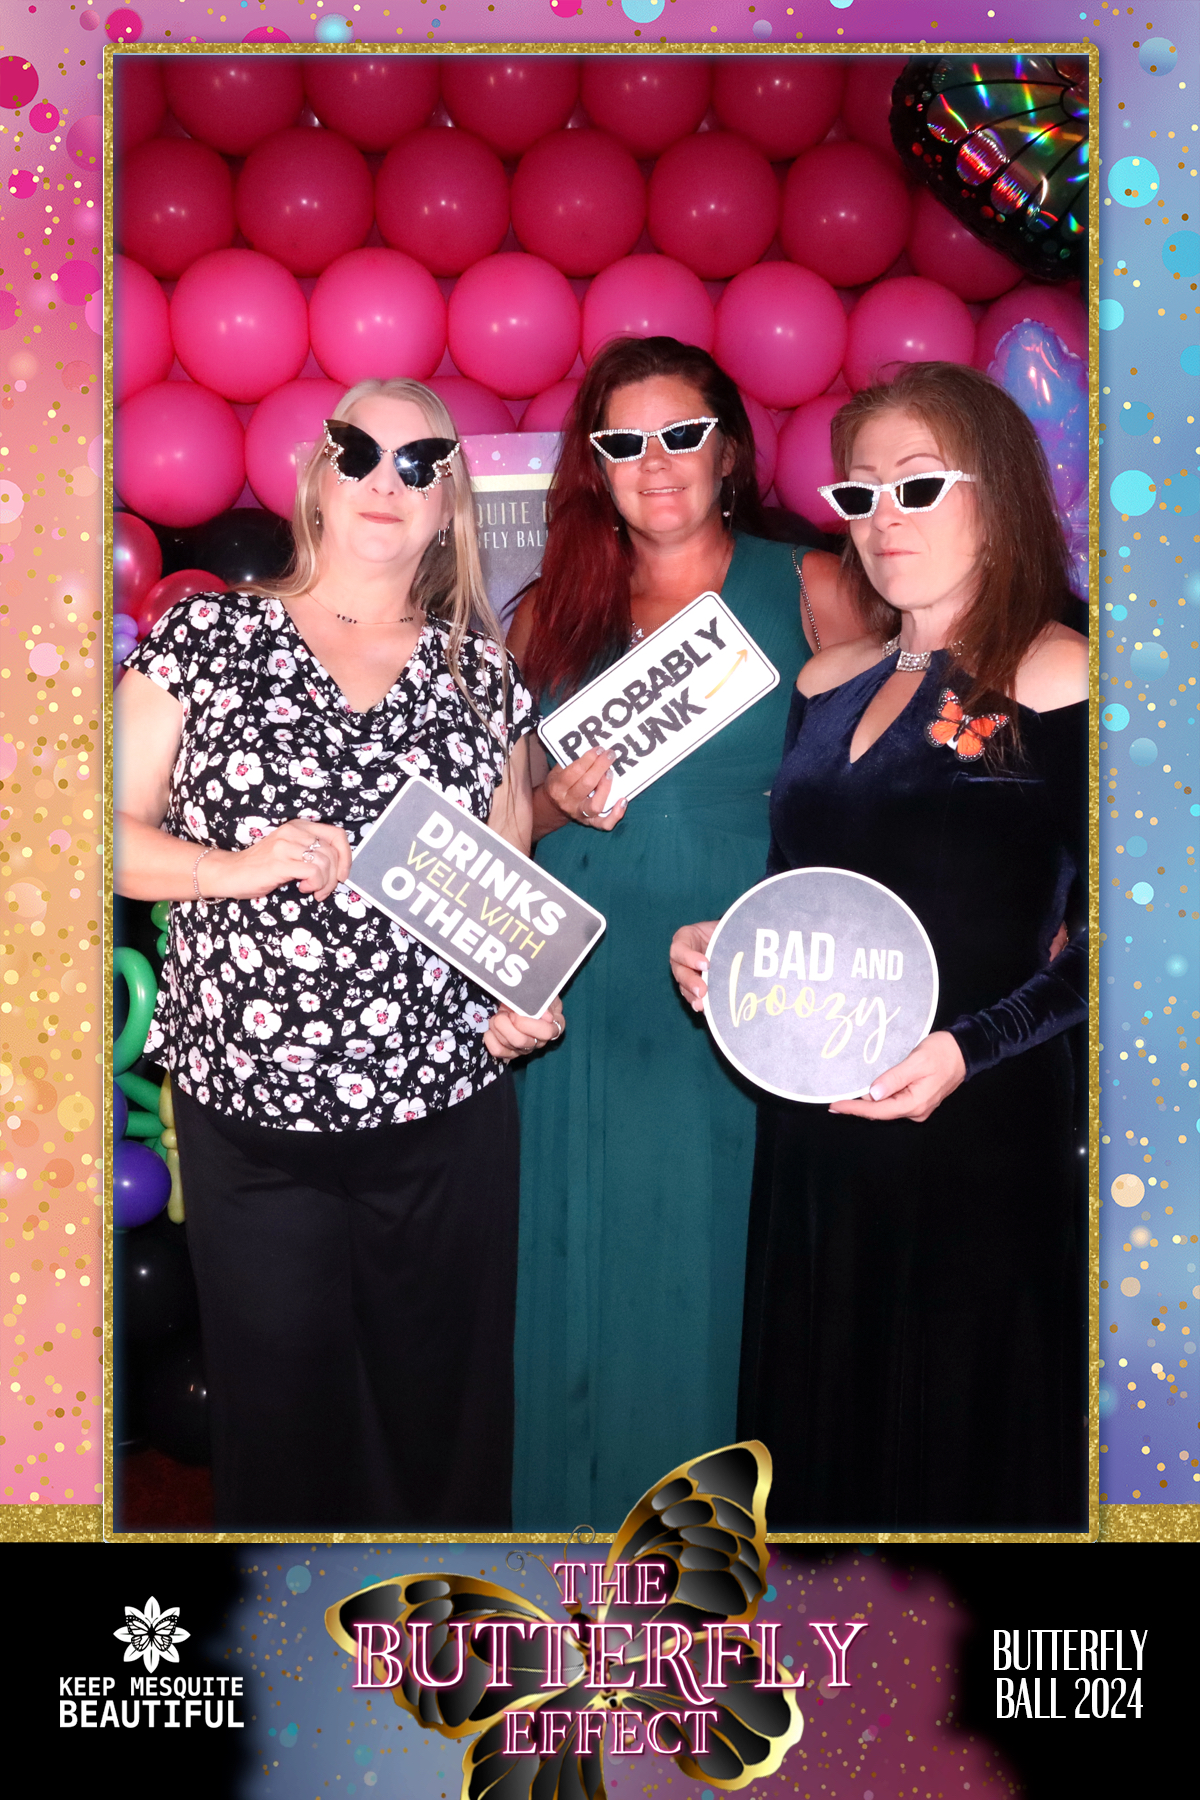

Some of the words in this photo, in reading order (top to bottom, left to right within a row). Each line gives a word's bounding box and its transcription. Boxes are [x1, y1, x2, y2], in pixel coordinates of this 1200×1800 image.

[478, 530, 509, 549] FLY
[558, 616, 727, 764] PROBABLY
[608, 686, 708, 778] RUNK
[381, 866, 530, 988] OTHERS
[406, 840, 470, 908] WELL
[479, 896, 546, 959] WITH
[416, 810, 567, 936] DRINKS
[728, 951, 902, 1064] boozy
[753, 928, 836, 982] BAD
[850, 947, 904, 981] AND
